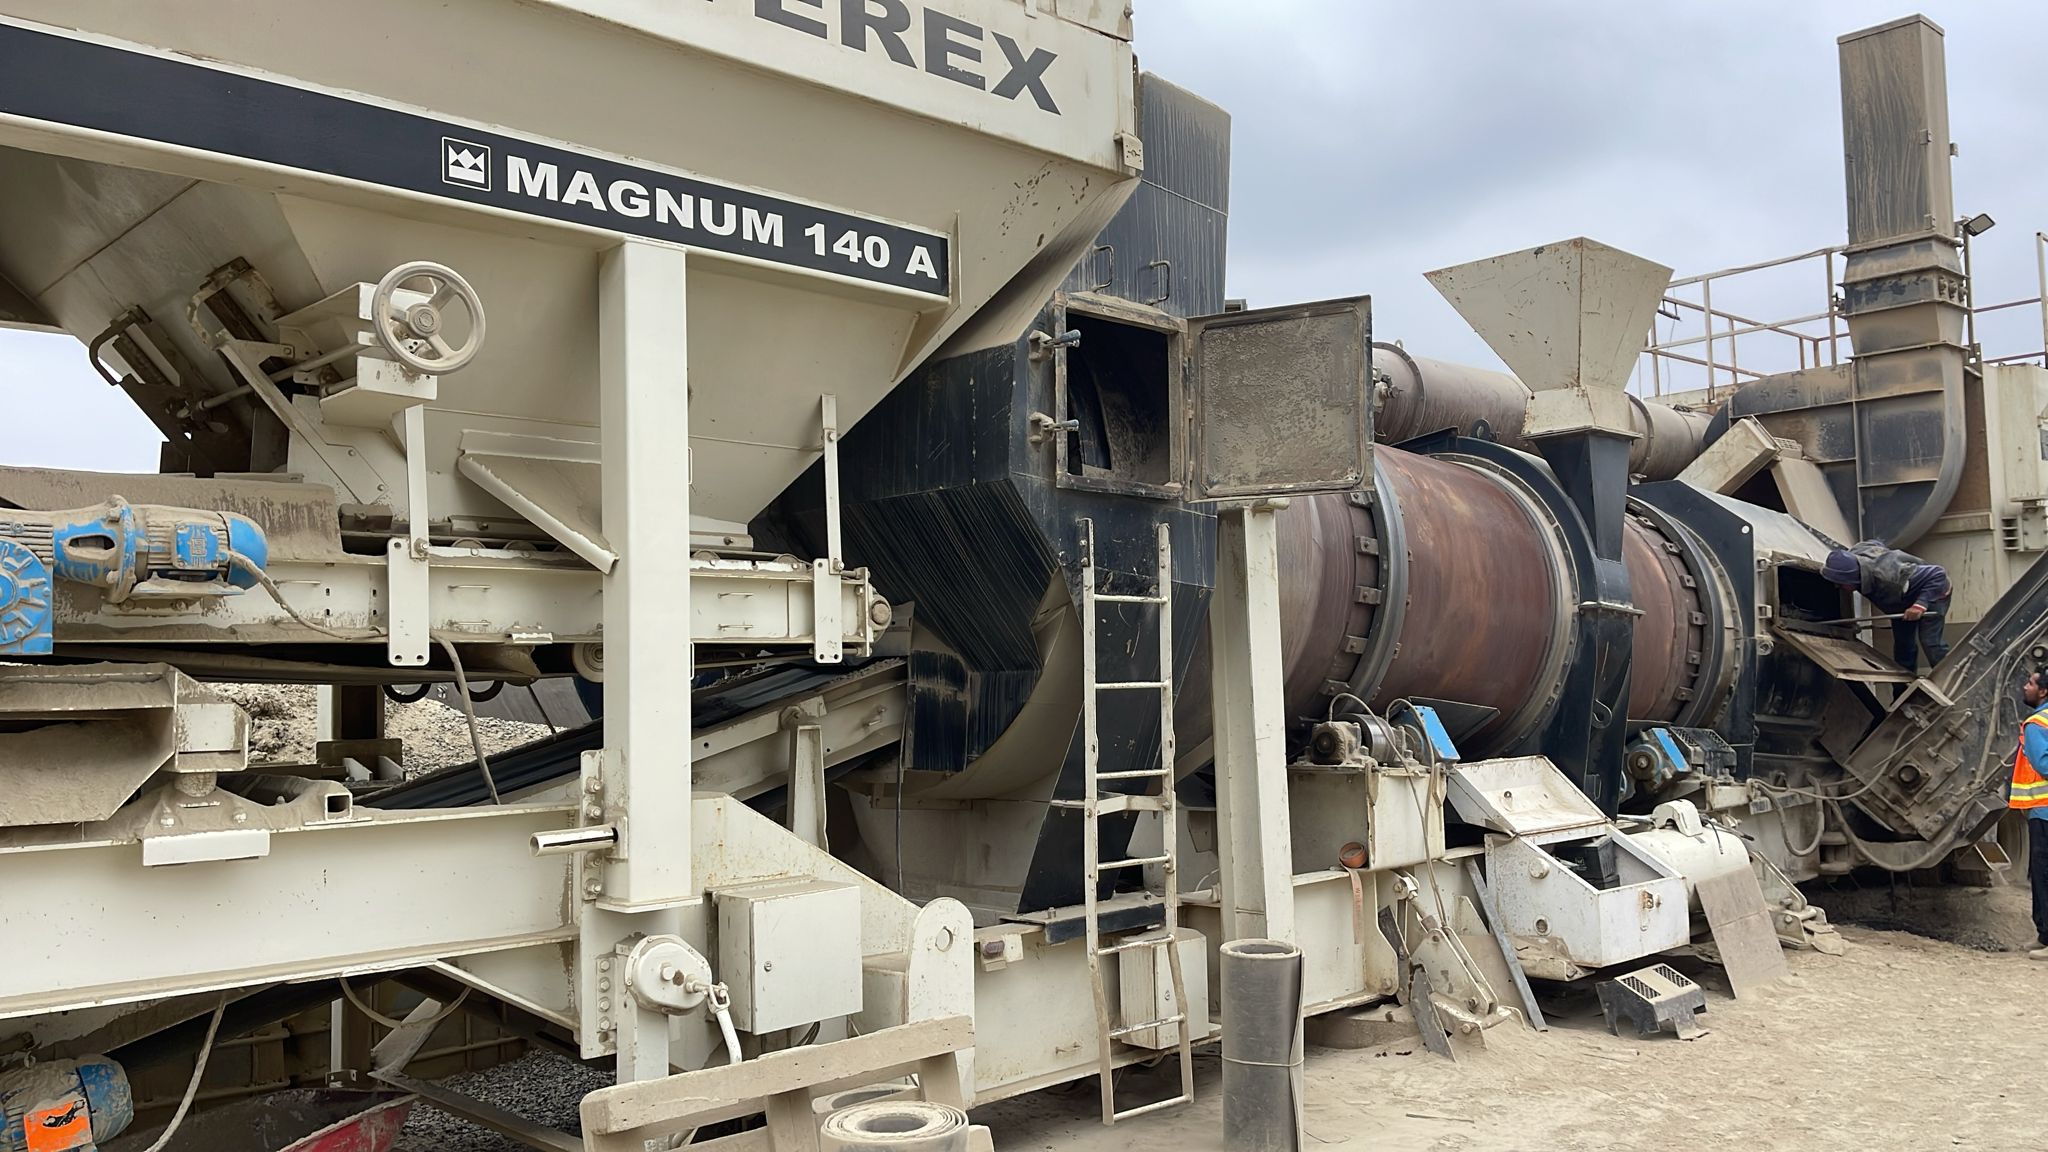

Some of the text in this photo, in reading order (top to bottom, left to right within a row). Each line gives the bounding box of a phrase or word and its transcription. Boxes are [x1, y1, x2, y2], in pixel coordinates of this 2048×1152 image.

[706, 0, 1061, 115] REX
[506, 155, 939, 280] MAGNUM 140 A
